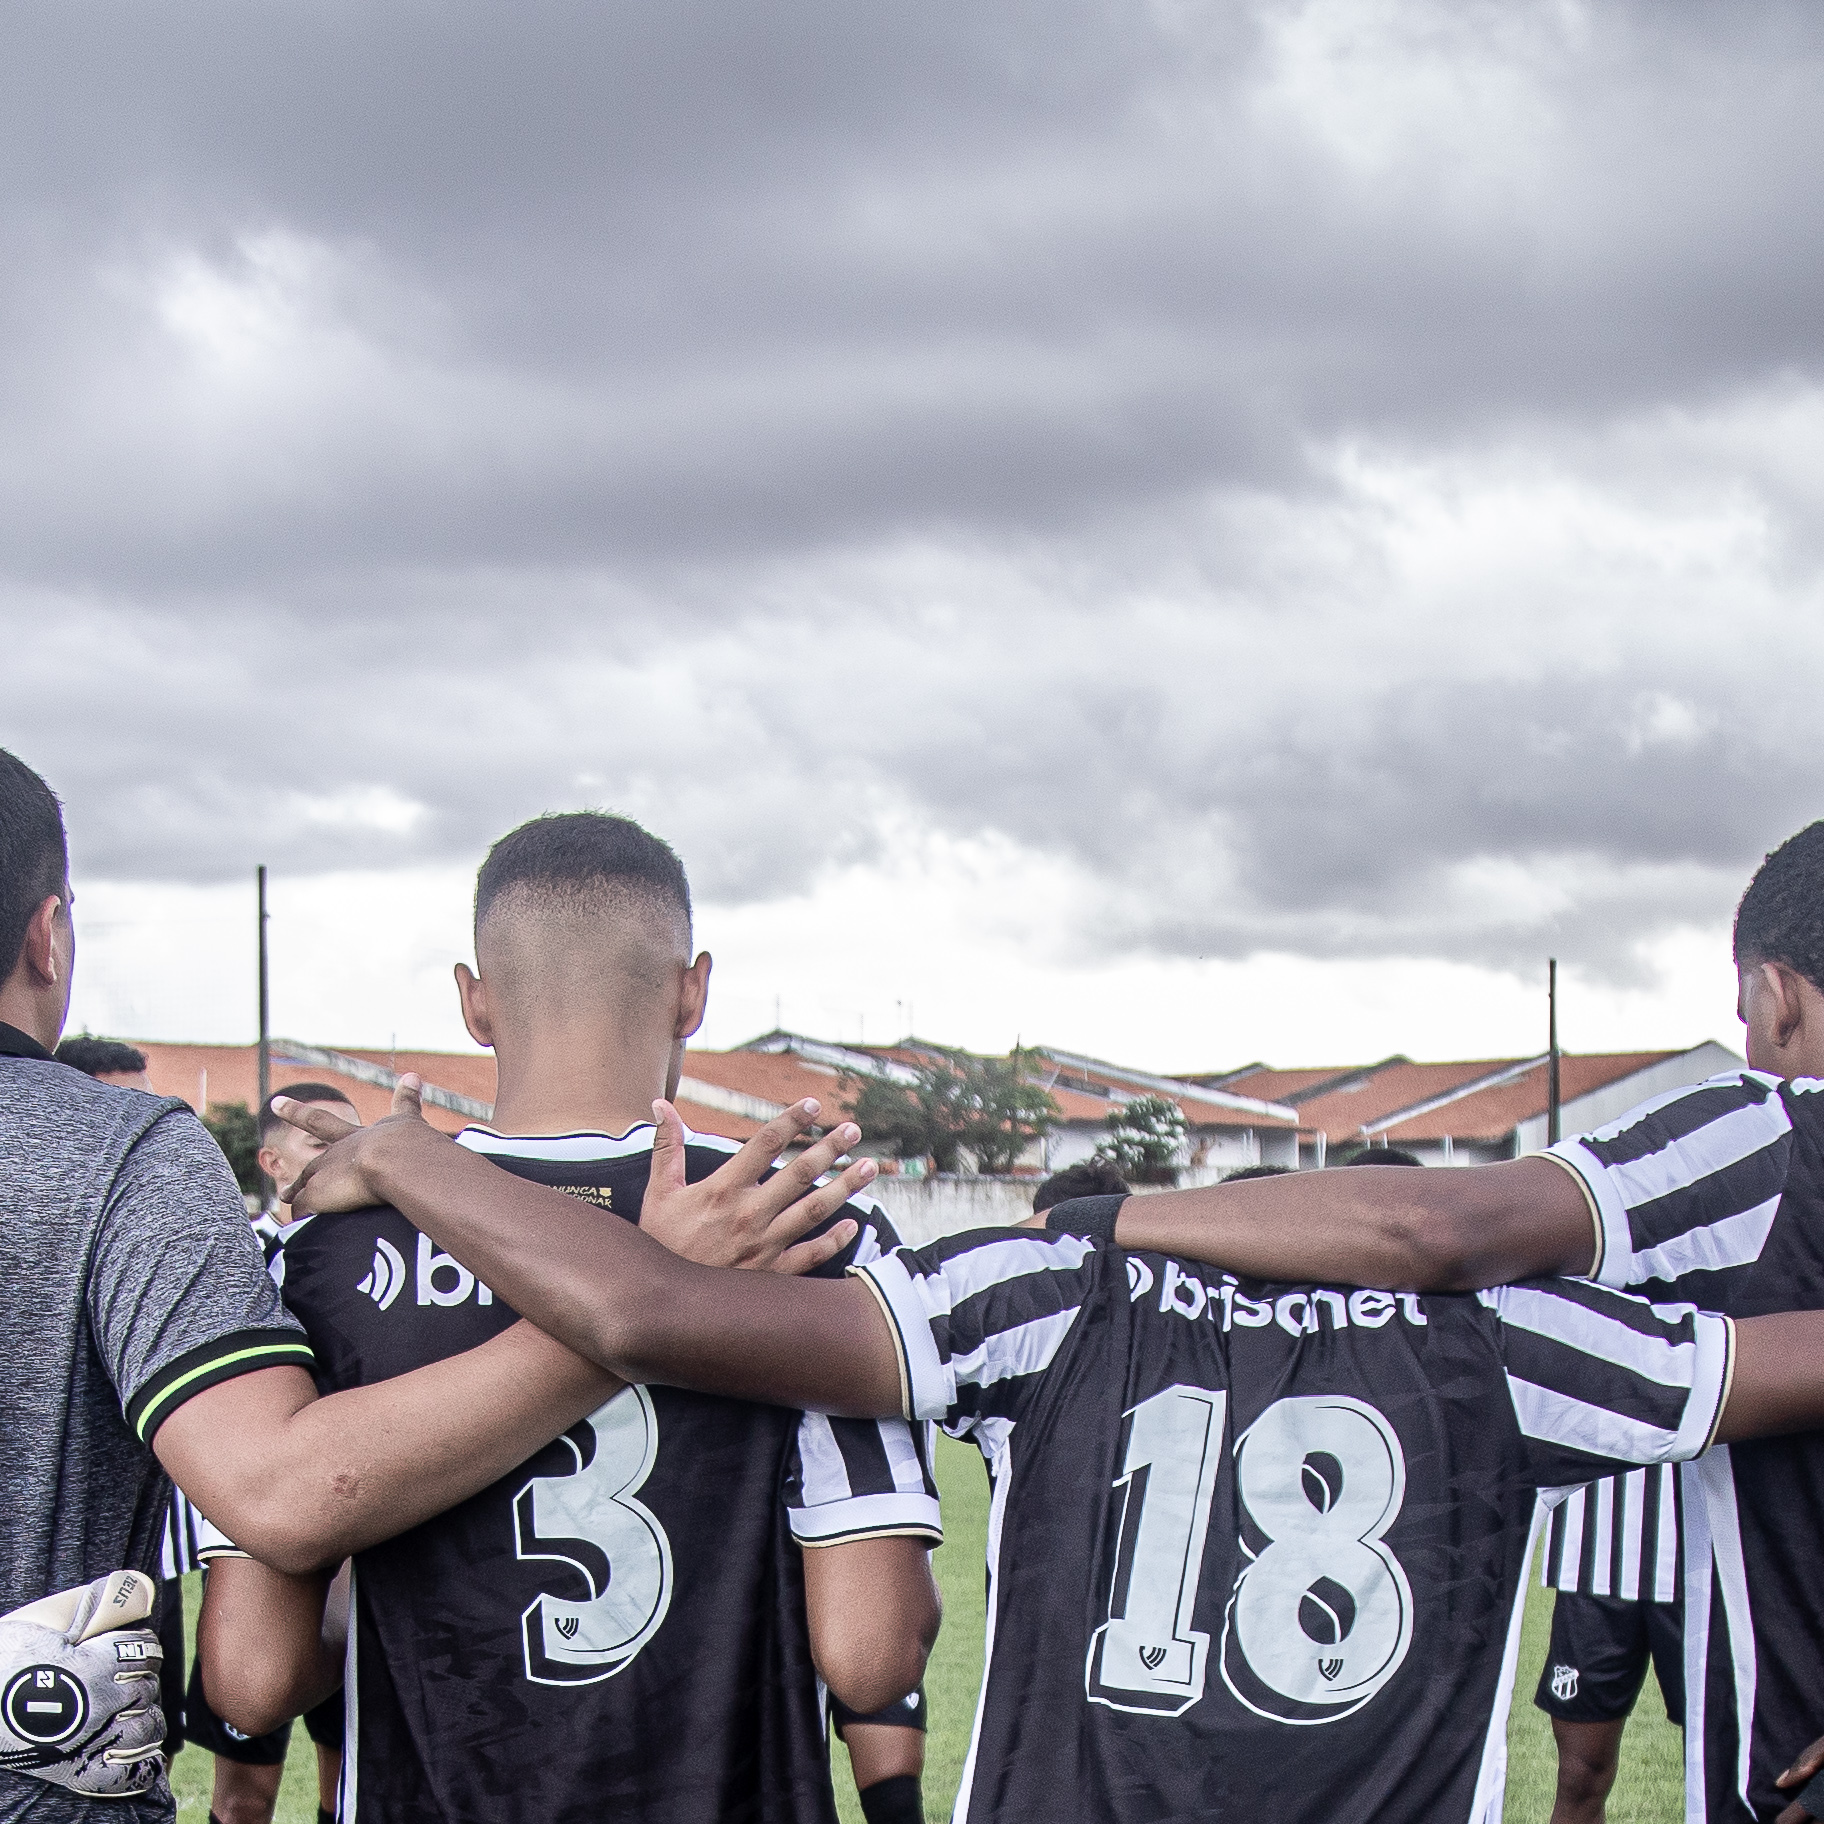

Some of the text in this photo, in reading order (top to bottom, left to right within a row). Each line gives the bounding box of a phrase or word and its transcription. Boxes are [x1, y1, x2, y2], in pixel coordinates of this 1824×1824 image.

[1159, 1258, 1427, 1338] brisanet
[513, 1385, 673, 1686] 3
[1085, 1384, 1415, 1726] 18
